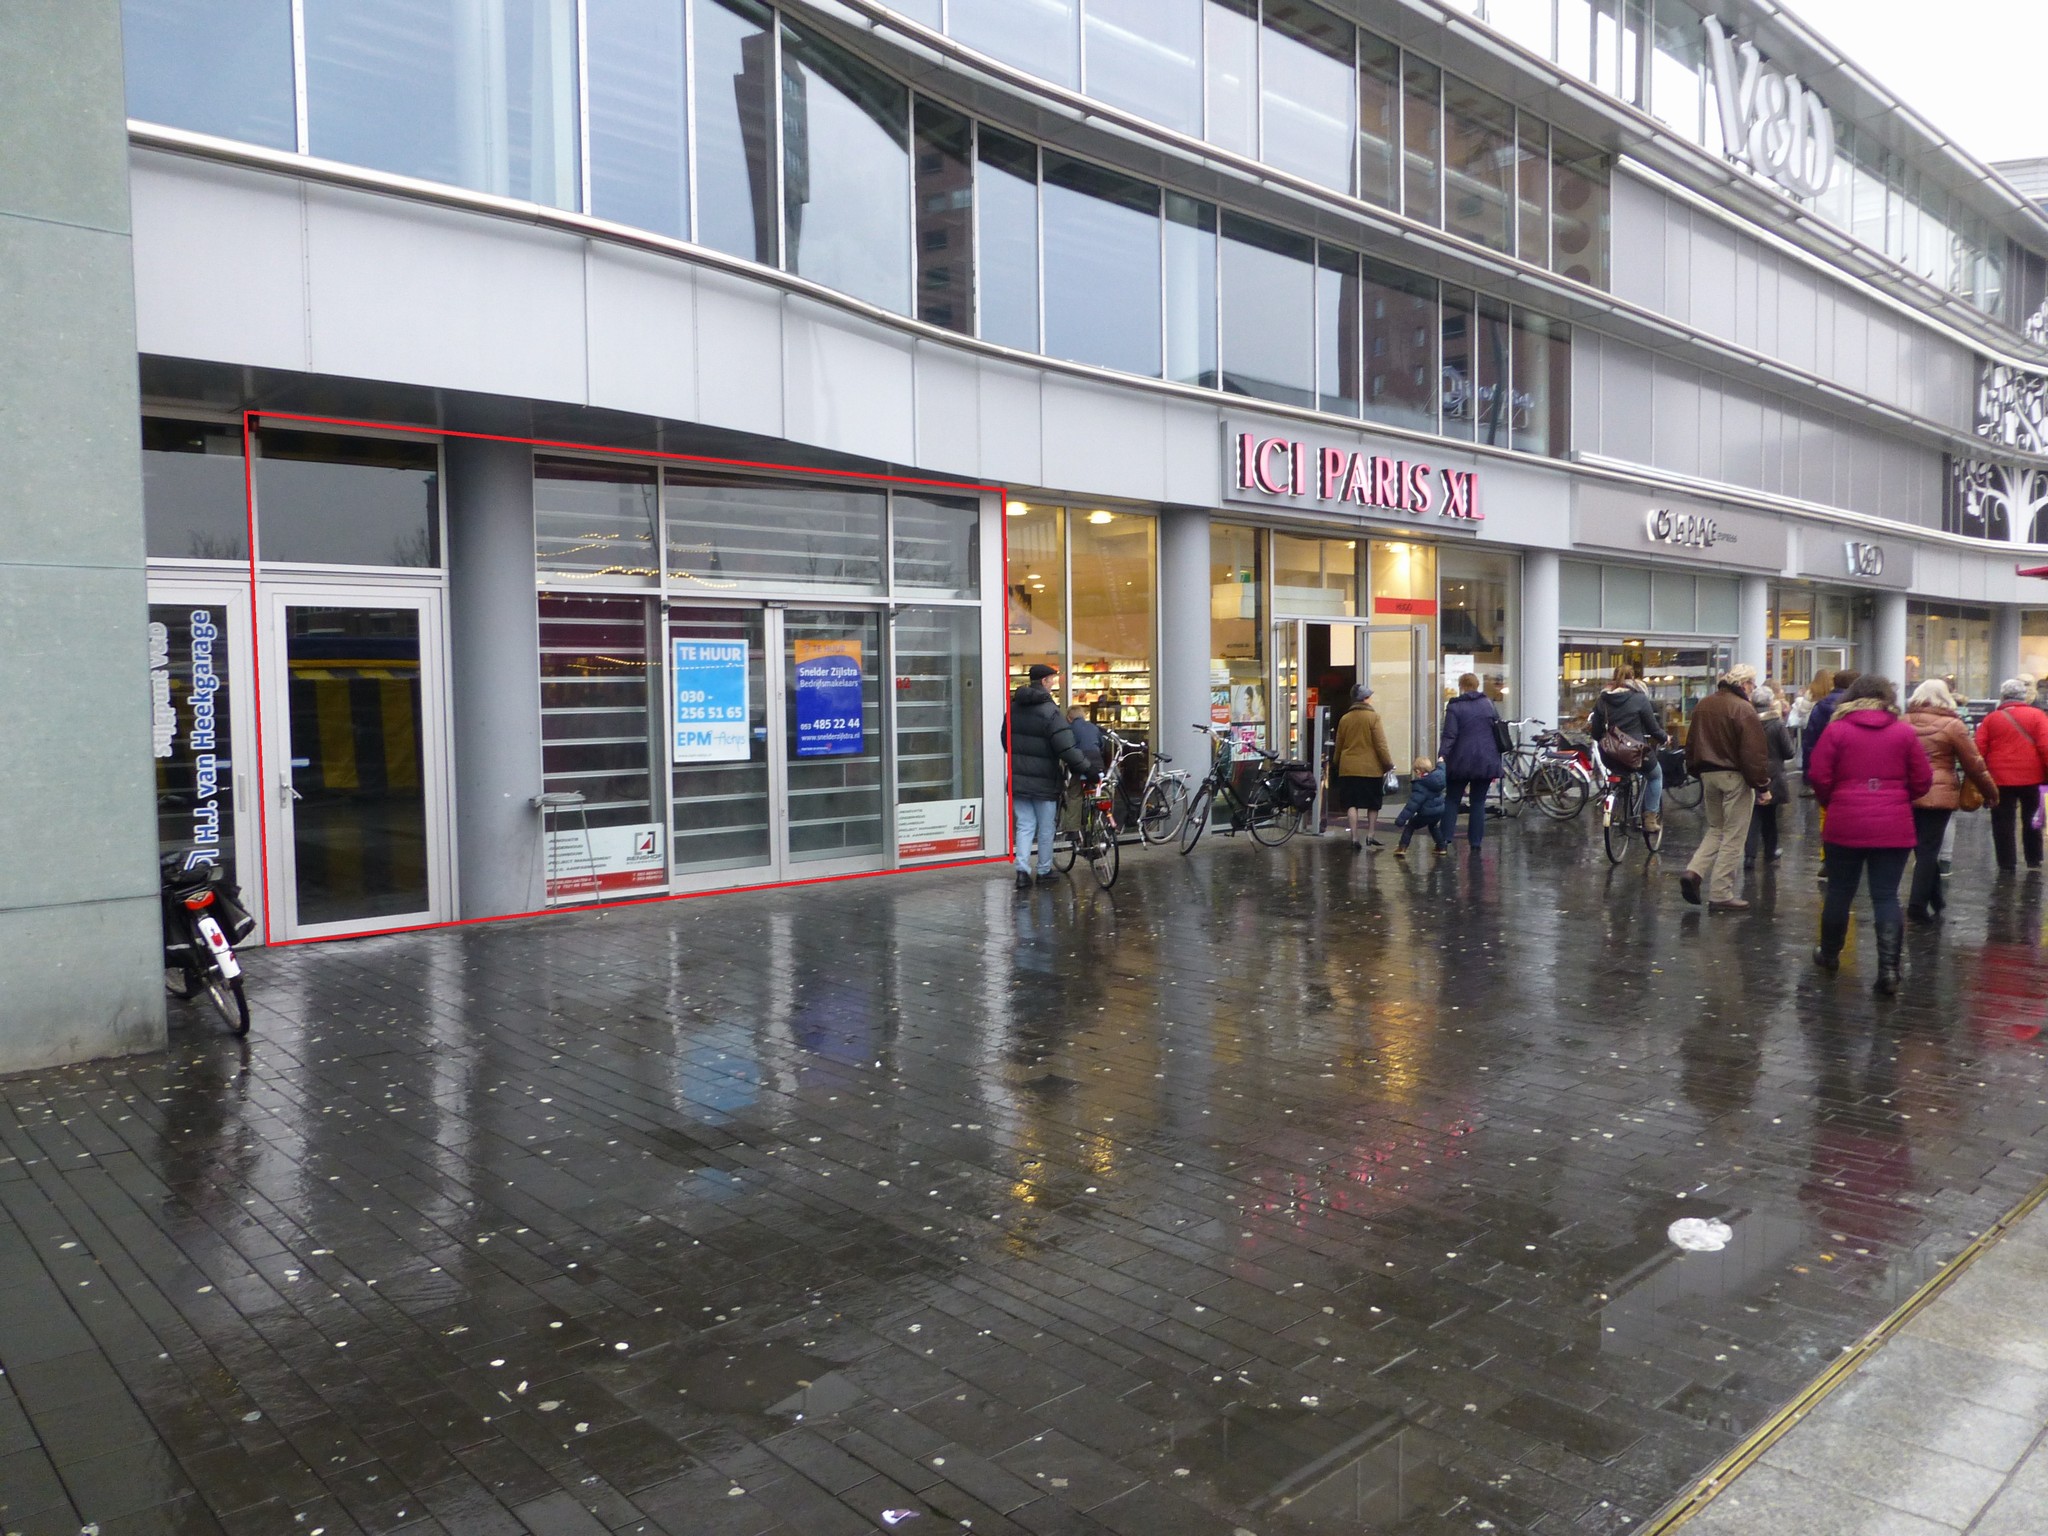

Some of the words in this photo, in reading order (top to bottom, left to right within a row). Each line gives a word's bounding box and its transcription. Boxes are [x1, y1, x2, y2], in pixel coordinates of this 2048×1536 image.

[1702, 13, 1834, 198] V&D
[1237, 433, 1305, 497] ICI
[1317, 447, 1432, 514] PARIS
[1440, 469, 1485, 521] XL
[1846, 542, 1884, 577] V&D
[680, 646, 696, 660] TE
[700, 647, 742, 661] HUUR
[187, 610, 219, 749] Heekgarage
[799, 666, 829, 677] Snelder
[830, 666, 858, 679] Zijlstra
[800, 679, 859, 690] Bedrijfsmakelaars
[681, 691, 705, 703] 030
[681, 707, 705, 719] 256
[708, 707, 724, 718] 51
[726, 706, 742, 718] 65
[813, 719, 831, 730] 485
[833, 718, 846, 729] 22
[847, 717, 860, 728] 44
[677, 732, 713, 747] EPM
[196, 754, 217, 799] van
[193, 800, 219, 844] H.J.
